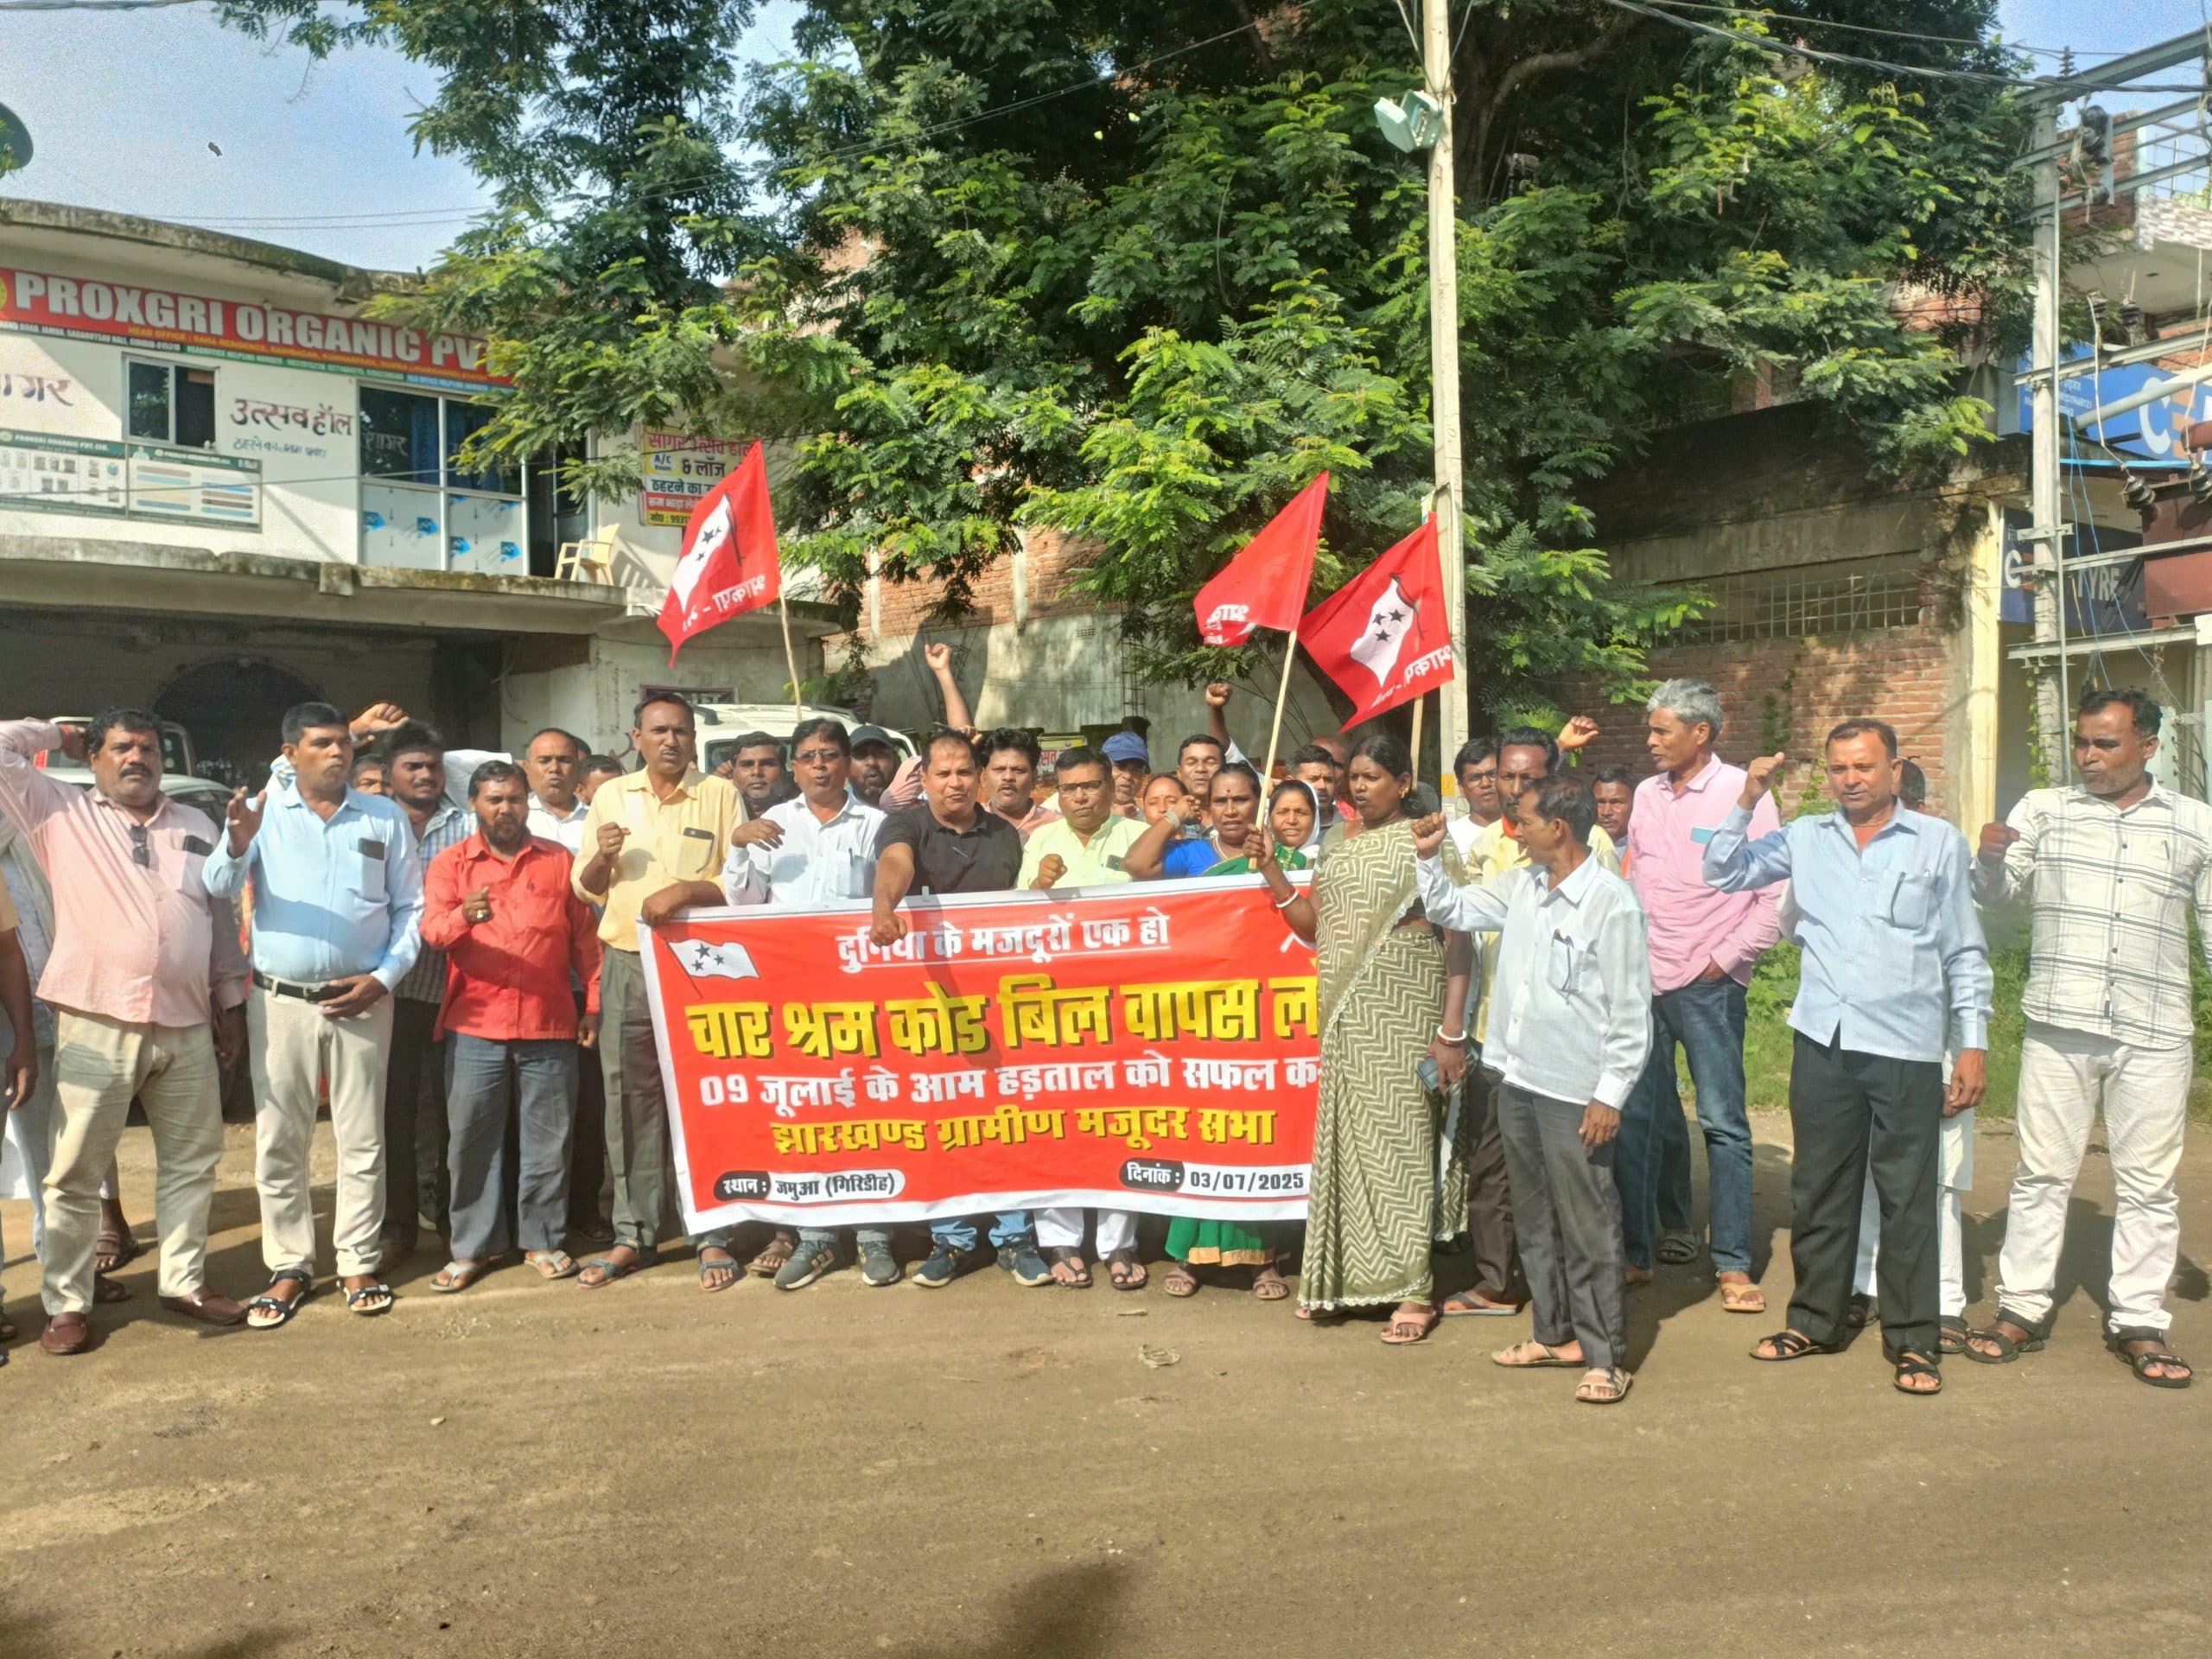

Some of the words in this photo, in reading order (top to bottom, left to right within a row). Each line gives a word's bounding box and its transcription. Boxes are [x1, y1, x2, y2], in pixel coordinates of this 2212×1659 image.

[14, 271, 224, 337] PROXGRI
[235, 306, 421, 362] ORGANIC
[229, 397, 309, 430] उत्सव
[651, 478, 684, 494] ठहरने
[687, 483, 702, 495] का
[694, 456, 725, 477] लॉज
[932, 920, 964, 958] के
[969, 913, 1074, 963] मजदूरों
[1080, 918, 1130, 948] एक
[1138, 906, 1170, 945] हो
[684, 1002, 772, 1058] चार
[782, 1001, 876, 1058] श्रम
[885, 982, 988, 1057] कोड
[995, 973, 1110, 1048] बिल
[1120, 978, 1260, 1040] वापस
[1268, 957, 1319, 1038] ल
[699, 1073, 749, 1106] 09
[757, 1067, 855, 1117] जूलाई
[862, 1065, 899, 1103] के
[910, 1070, 987, 1103] आम
[995, 1060, 1116, 1101] हड़ताल
[1125, 1050, 1172, 1090] को
[1181, 1058, 1278, 1091] सफल
[1284, 1057, 1322, 1090] क
[770, 1120, 927, 1154] झारखण्ड
[935, 1104, 1065, 1152] ग्रामीण
[1073, 1106, 1191, 1150] मजूदर
[1197, 1108, 1277, 1145] सभा
[775, 1180, 820, 1201] जमुआ
[825, 1172, 895, 1198] (गिरिडीह)
[1190, 1171, 1305, 1192] 03/07/2025
